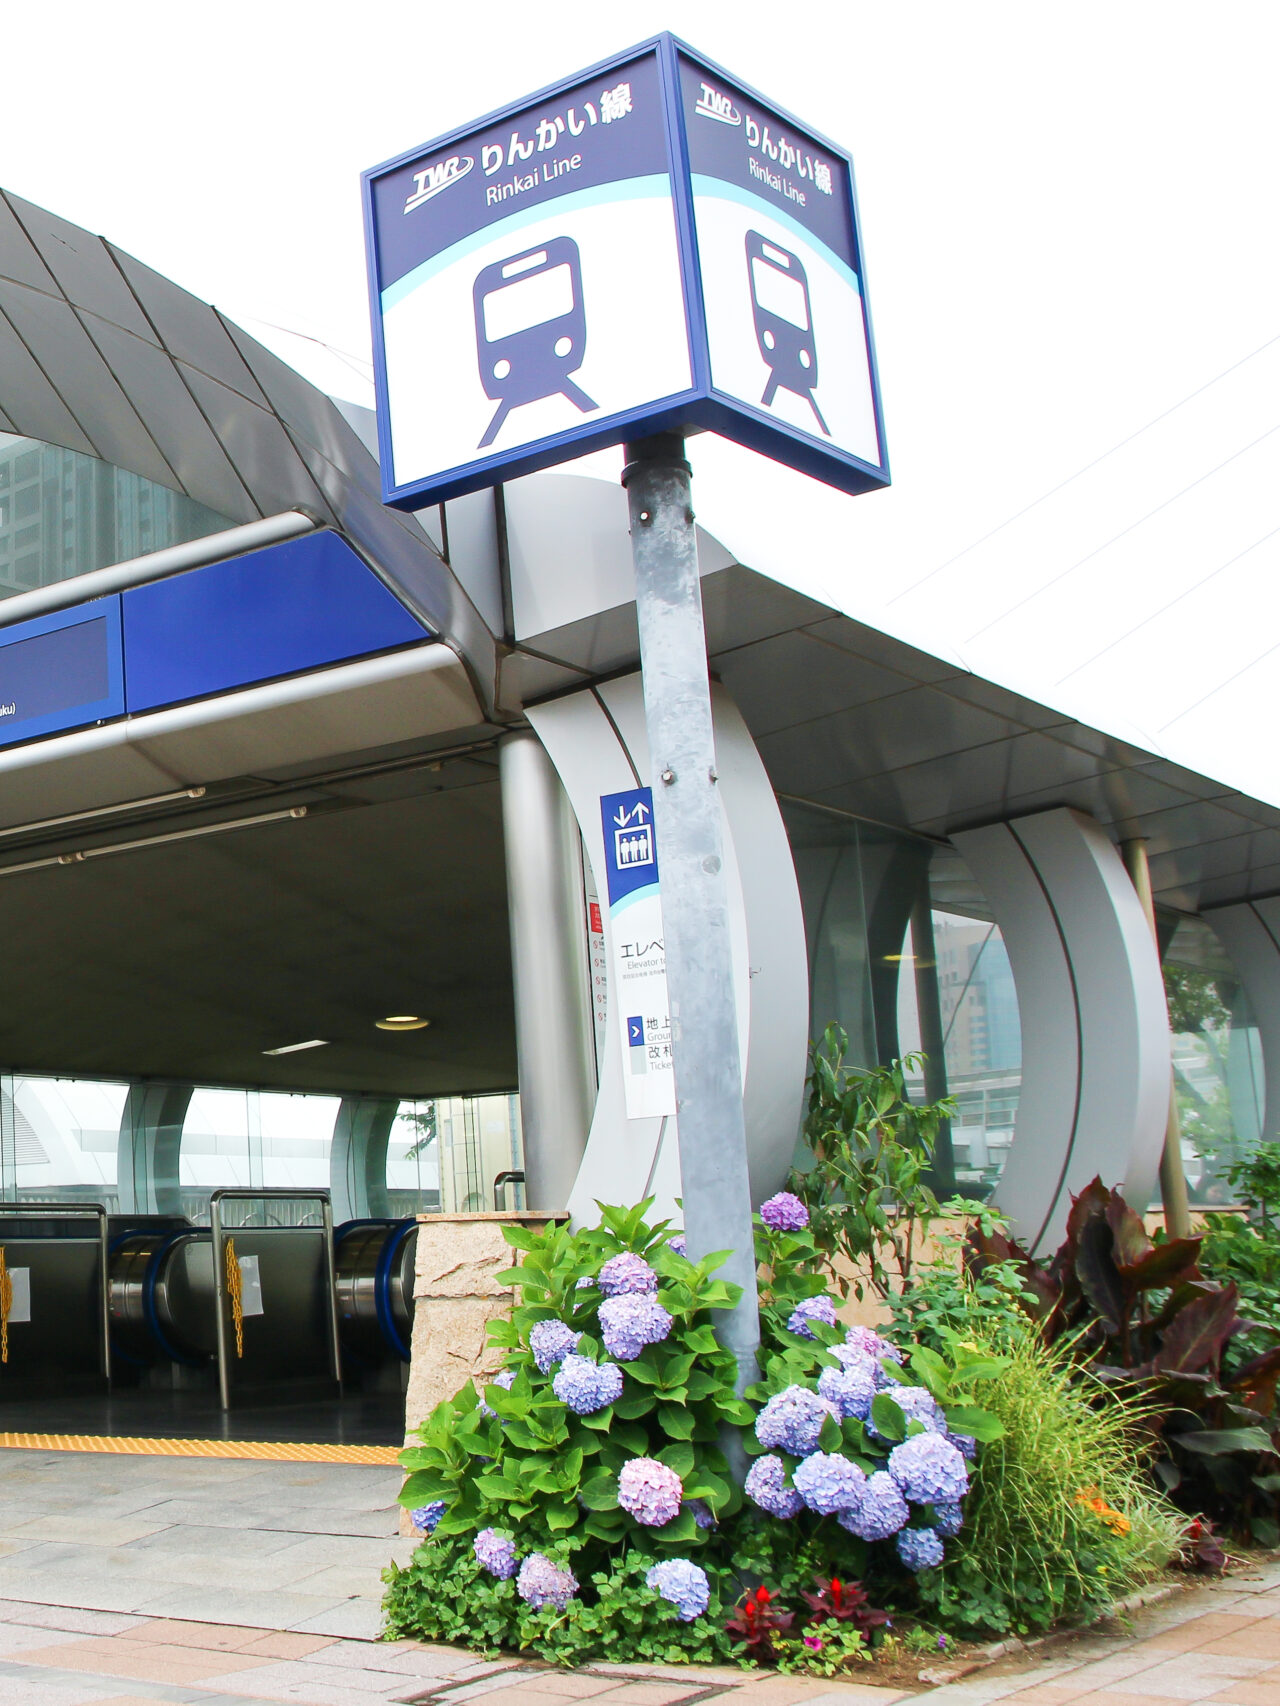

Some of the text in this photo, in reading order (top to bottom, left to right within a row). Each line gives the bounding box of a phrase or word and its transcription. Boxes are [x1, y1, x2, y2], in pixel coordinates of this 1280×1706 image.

[404, 83, 633, 204] TWR りんかい線
[697, 82, 832, 195] TWR りんかい線
[485, 154, 582, 206] Rinkai Line
[749, 157, 806, 207] Rinkai Line
[621, 938, 664, 958] エレベ
[627, 959, 658, 970] Elevator
[646, 1015, 671, 1030] 地上
[647, 1032, 671, 1042] Groun
[648, 1044, 672, 1059] 改札
[650, 1061, 671, 1071] Ticke
